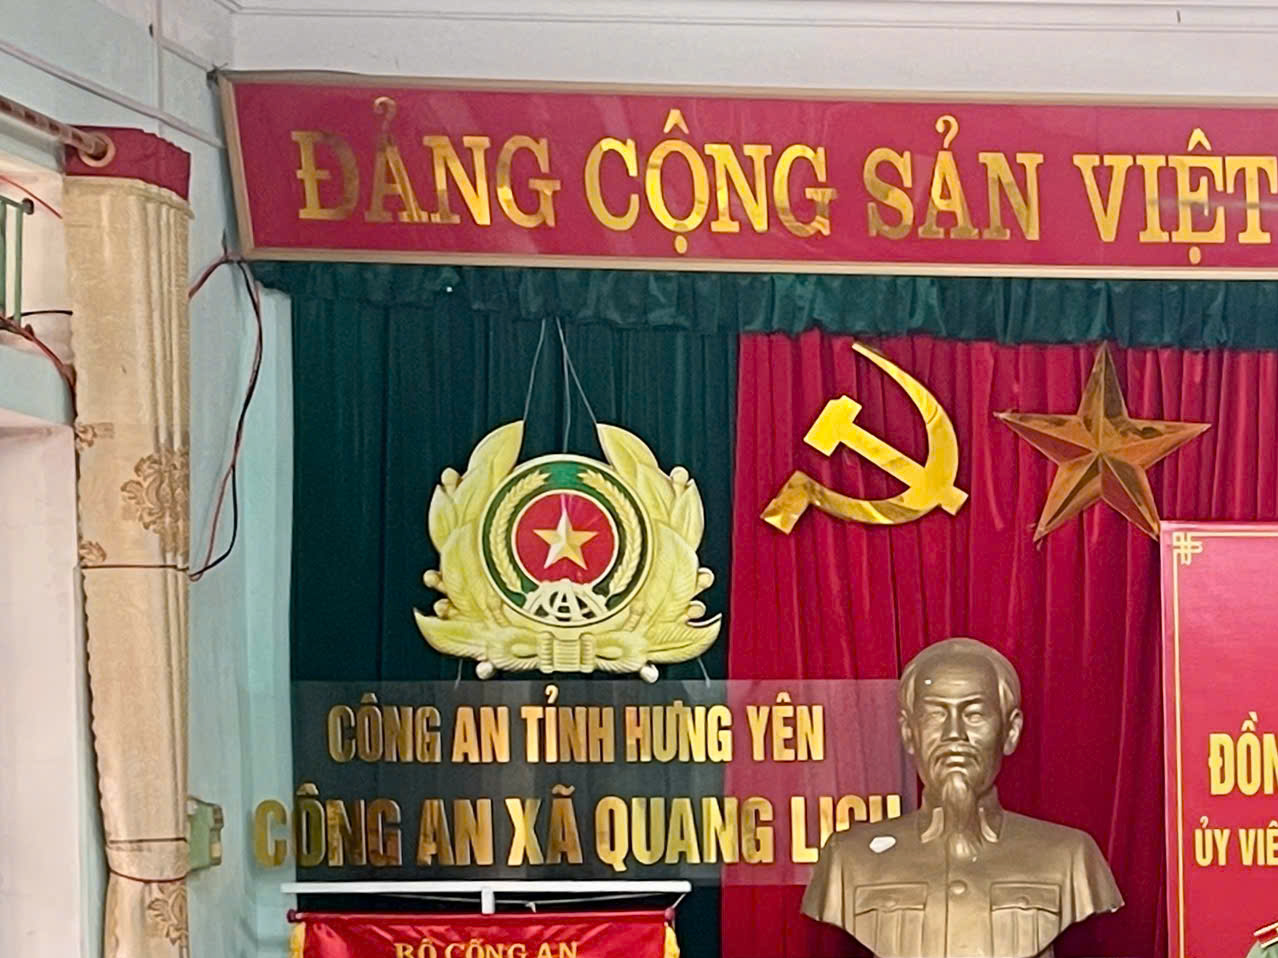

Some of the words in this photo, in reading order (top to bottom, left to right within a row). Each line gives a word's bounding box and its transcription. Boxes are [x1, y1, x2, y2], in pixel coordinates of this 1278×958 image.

[292, 96, 562, 229] ĐẢNG
[584, 109, 837, 254] CỘNG
[864, 115, 1043, 240] SẢN
[1073, 128, 1278, 265] VIỆT
[327, 692, 441, 763] CÔNG
[451, 706, 510, 763] AN
[521, 684, 614, 763] TỈNH
[625, 700, 733, 763] HƯNG
[746, 691, 824, 762] YÊN
[253, 783, 401, 868] CÔNG
[417, 797, 493, 867] AN
[505, 784, 583, 867] XÃ
[594, 796, 775, 872] QUANG
[1193, 814, 1231, 868] ỦY
